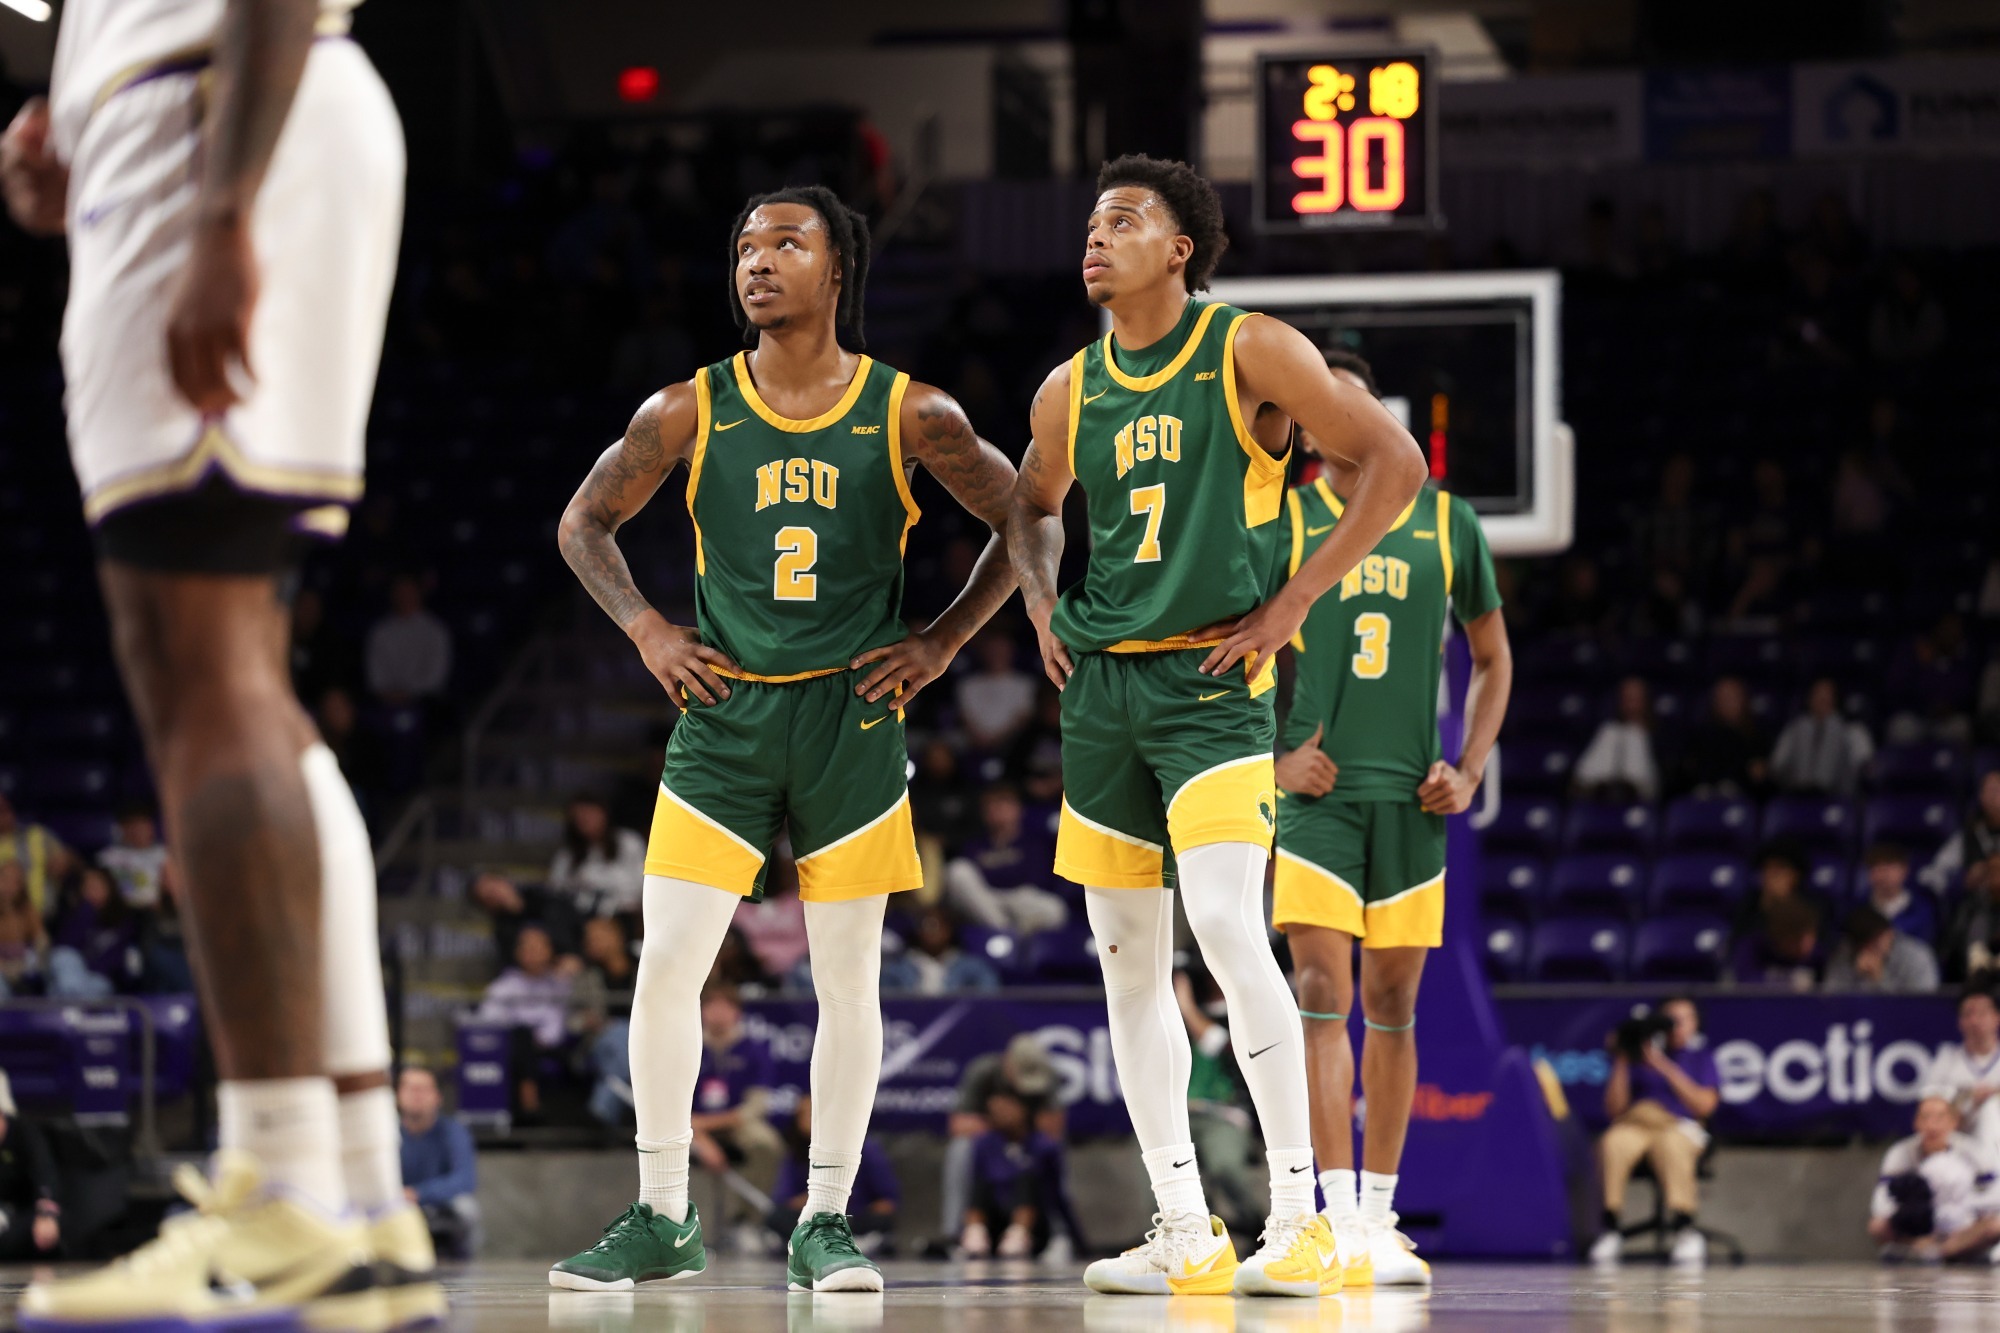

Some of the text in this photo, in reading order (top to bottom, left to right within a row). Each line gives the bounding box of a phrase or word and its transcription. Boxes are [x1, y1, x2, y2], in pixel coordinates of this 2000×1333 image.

[1292, 117, 1404, 213] 30
[1194, 368, 1217, 382] MEA
[851, 425, 880, 435] MEAC
[1114, 415, 1183, 480] NSU
[755, 457, 839, 512] NSU
[1130, 482, 1165, 563] 7
[774, 526, 817, 601] 2
[1352, 612, 1391, 679] 3
